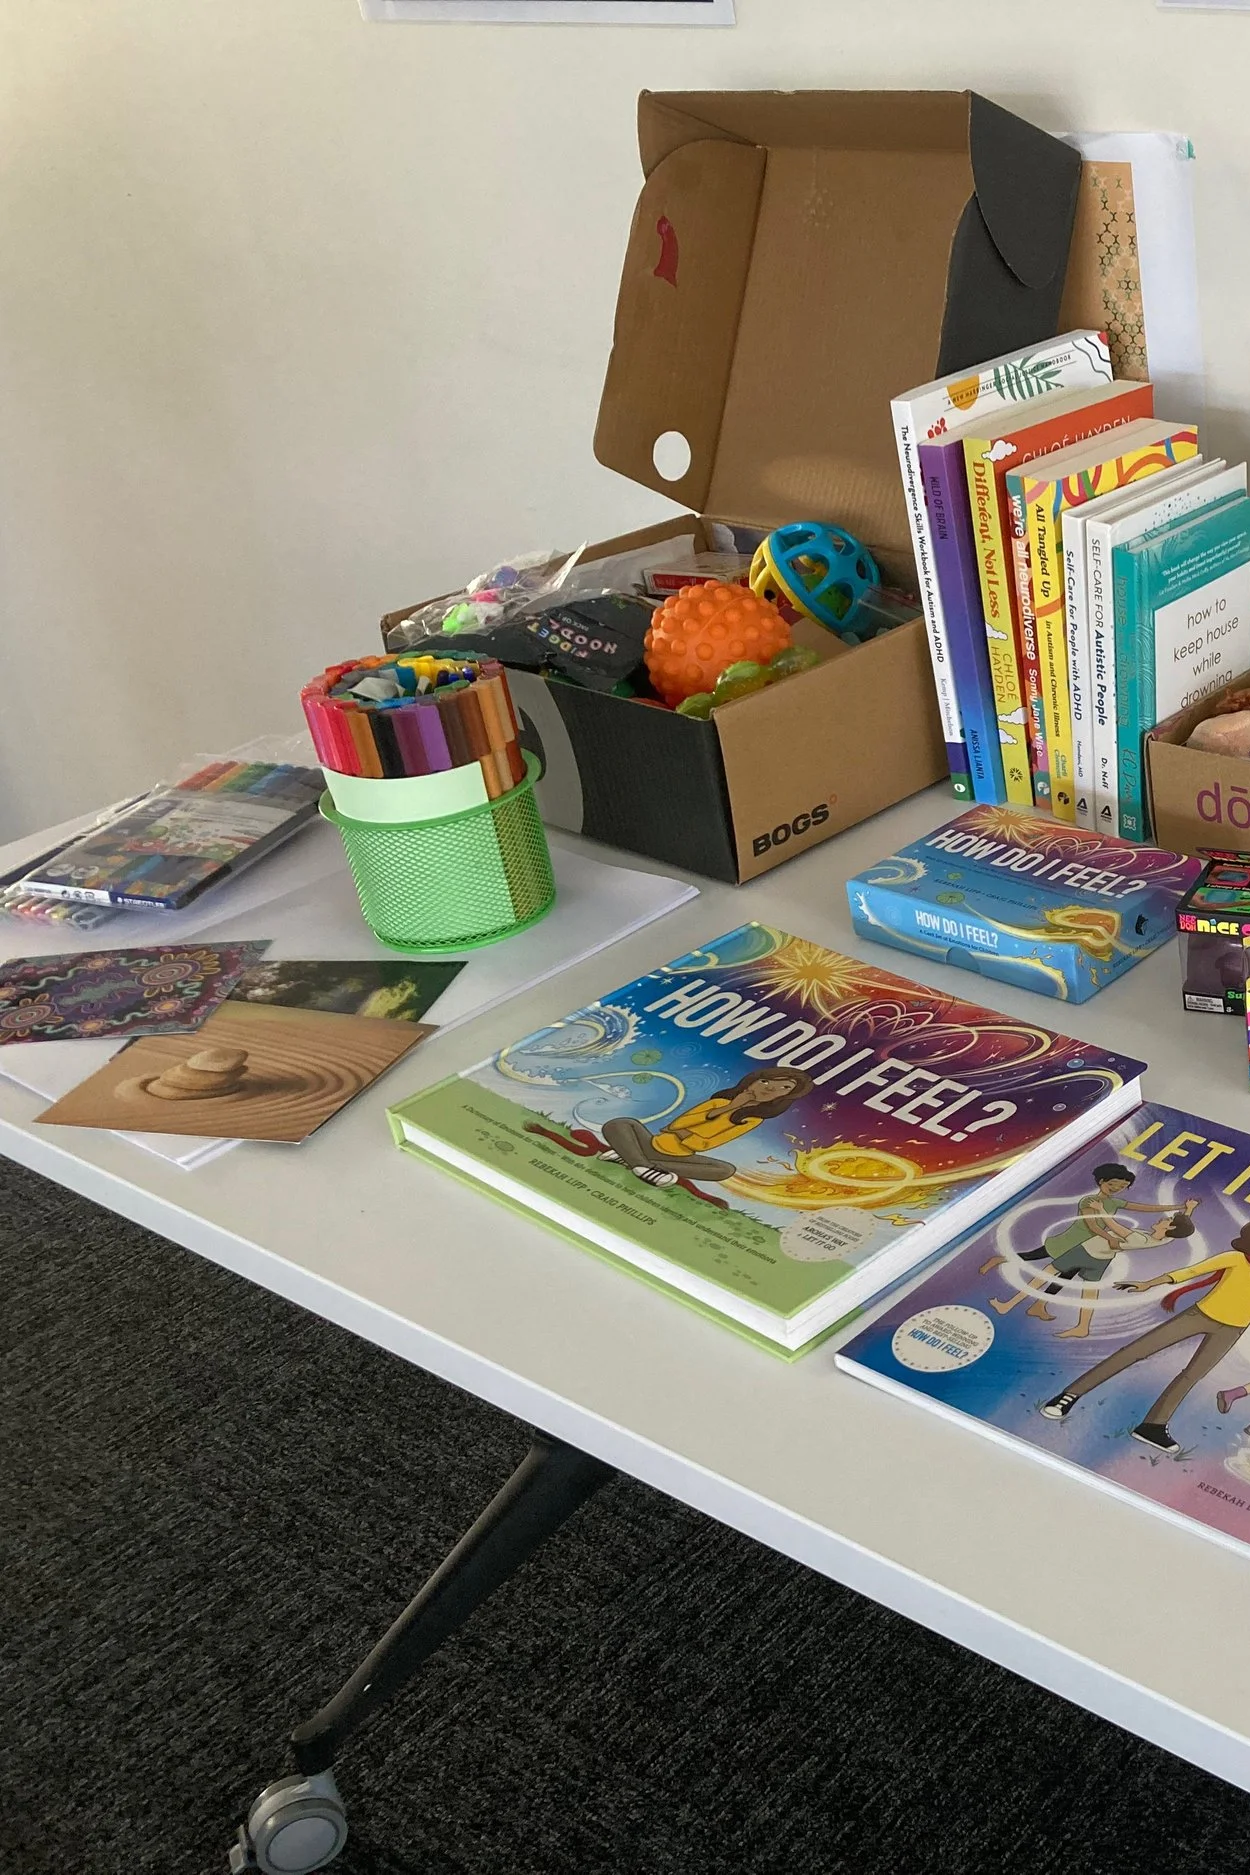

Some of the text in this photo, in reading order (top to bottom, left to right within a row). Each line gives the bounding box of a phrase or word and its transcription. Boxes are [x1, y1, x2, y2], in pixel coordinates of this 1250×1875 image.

[901, 426, 944, 663] The Neurodivergence Skills Workbook for Autism and ADHD
[973, 462, 1003, 618] Different, Not Less
[1035, 504, 1051, 597] All Tangled Up
[1012, 494, 1037, 660] we're all neurodiverse
[1066, 550, 1082, 720] Self-Care for People with ADHD
[1091, 538, 1107, 725] SELF-CARE FOR Autistic People
[1173, 616, 1239, 663] keep house
[1187, 598, 1226, 629] how to
[991, 646, 1006, 703] HAYDEN
[1003, 653, 1018, 700] CHLOÉ
[1045, 620, 1060, 736] in Autism and Chronic Illness
[1192, 652, 1222, 677] while
[1027, 669, 1045, 756] Sonny Jane Wise
[752, 803, 829, 857] BOGS
[926, 829, 997, 861] HOW
[992, 847, 1034, 872] DO
[1033, 857, 1060, 878] I
[1048, 862, 1147, 899] FEEL?
[915, 910, 999, 948] HOW DO I FEEL?
[645, 979, 1018, 1144] HOW DO I FEEL?
[1120, 1123, 1203, 1181] LET
[528, 1157, 658, 1226] REBEKAH LIPP CRAIG PHILLIPS
[908, 1328, 969, 1359] HOW DO I FEEL?
[1197, 1481, 1246, 1508] REBEKAH
